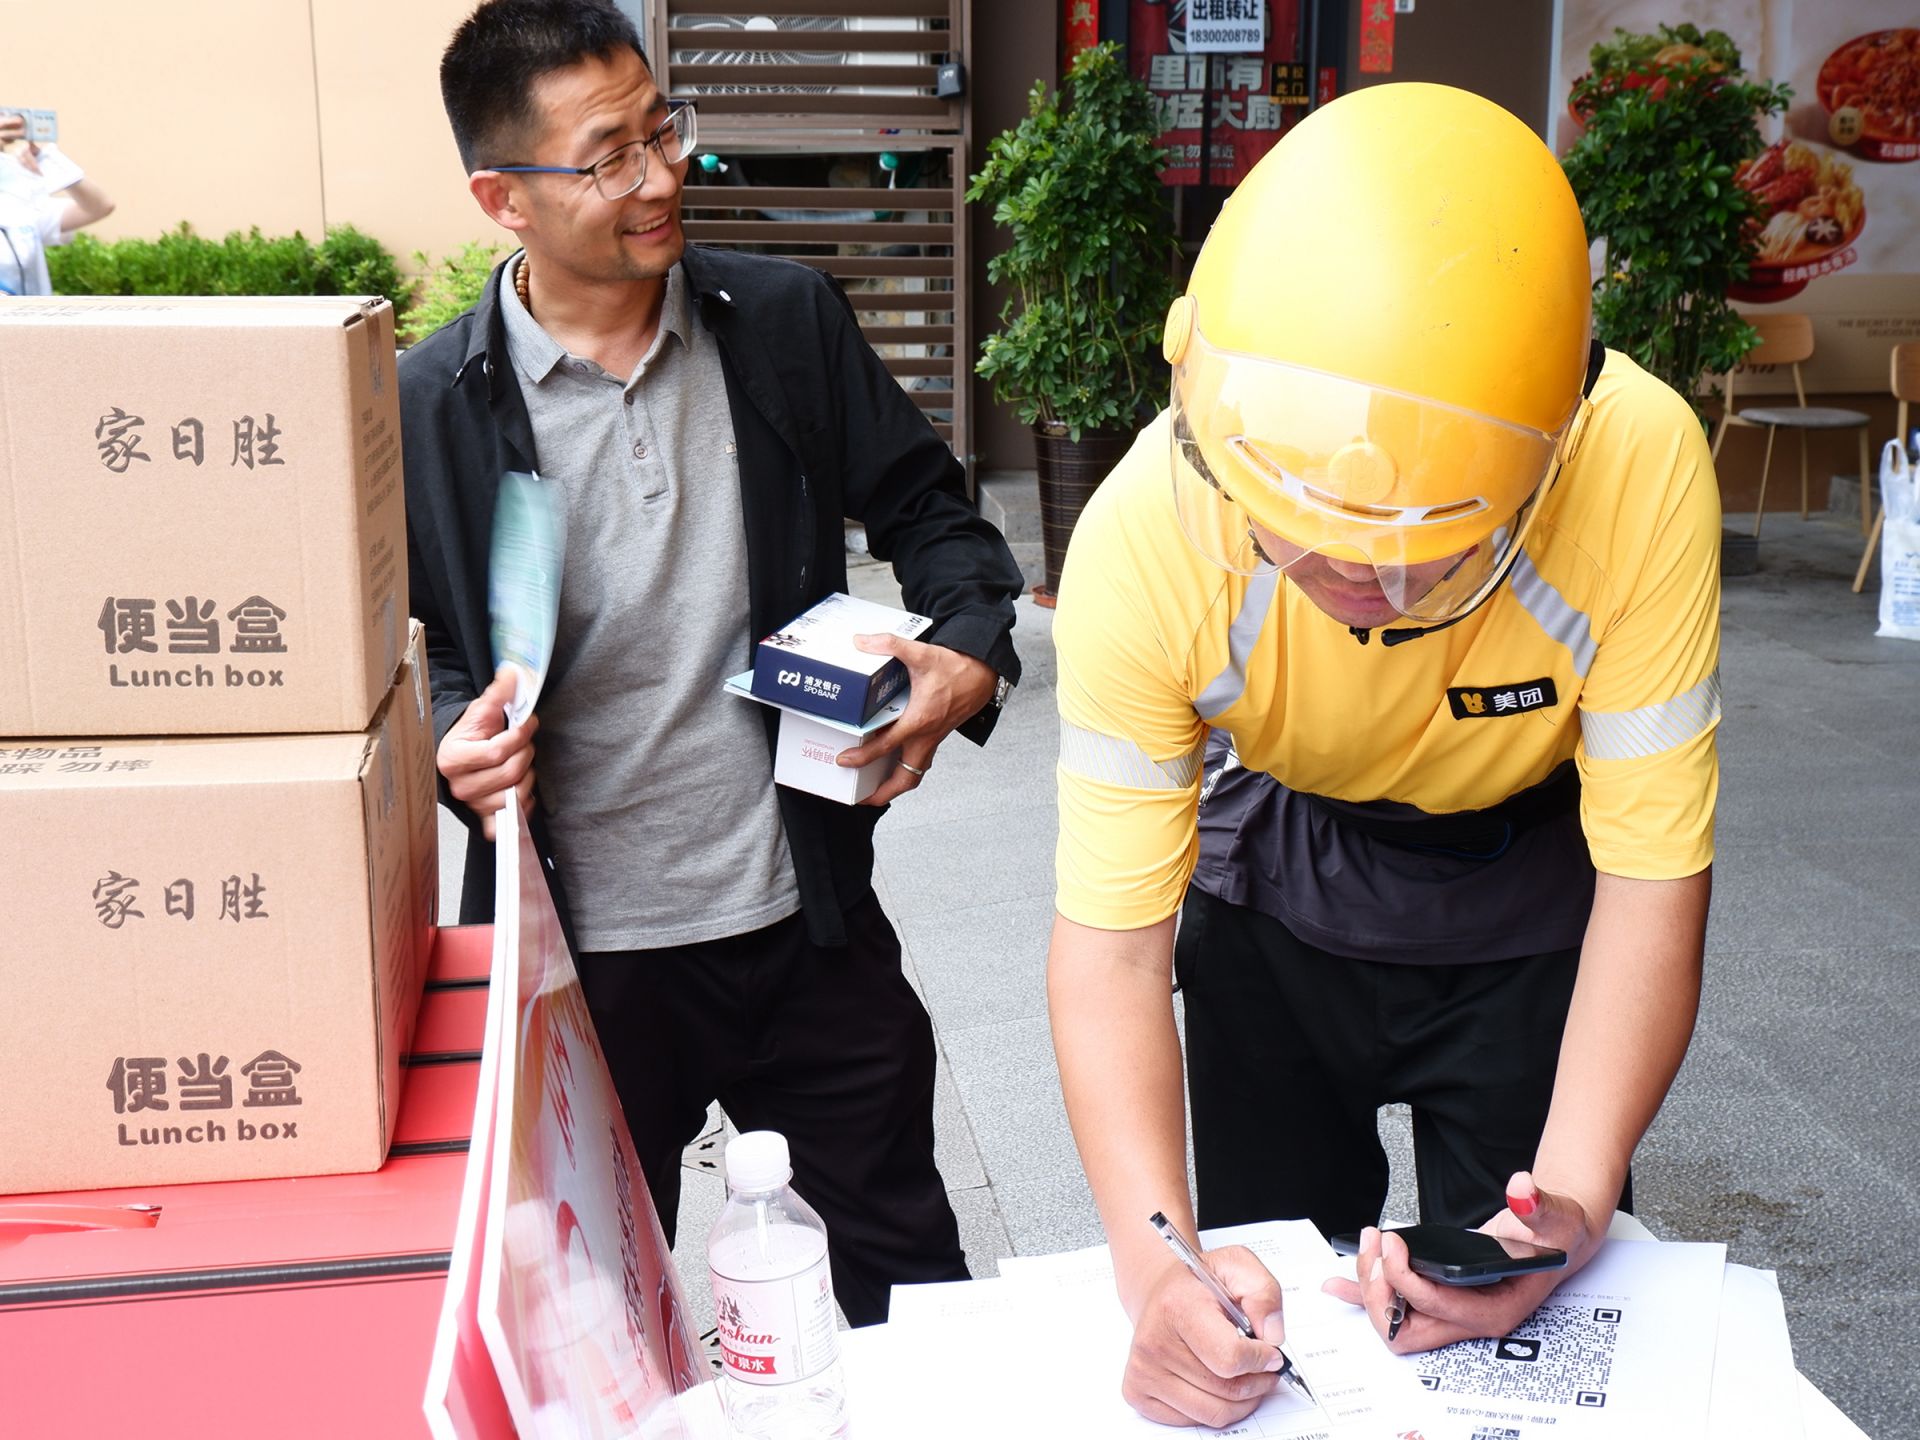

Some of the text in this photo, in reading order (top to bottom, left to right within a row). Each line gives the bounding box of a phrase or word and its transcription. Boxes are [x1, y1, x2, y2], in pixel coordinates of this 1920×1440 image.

[1192, 0, 1258, 20] 出租转让
[1189, 28, 1260, 43] 18300208789
[1155, 94, 1282, 130] 猛大厨
[95, 406, 286, 474] 家日胜
[97, 595, 288, 655] 便当盒
[109, 664, 285, 688] Lunch box
[1493, 687, 1544, 712] 美团
[92, 870, 270, 930] 家日胜
[106, 1050, 303, 1114] 便当盒
[117, 1118, 299, 1147] Lunch box
[718, 1324, 781, 1344] oshan
